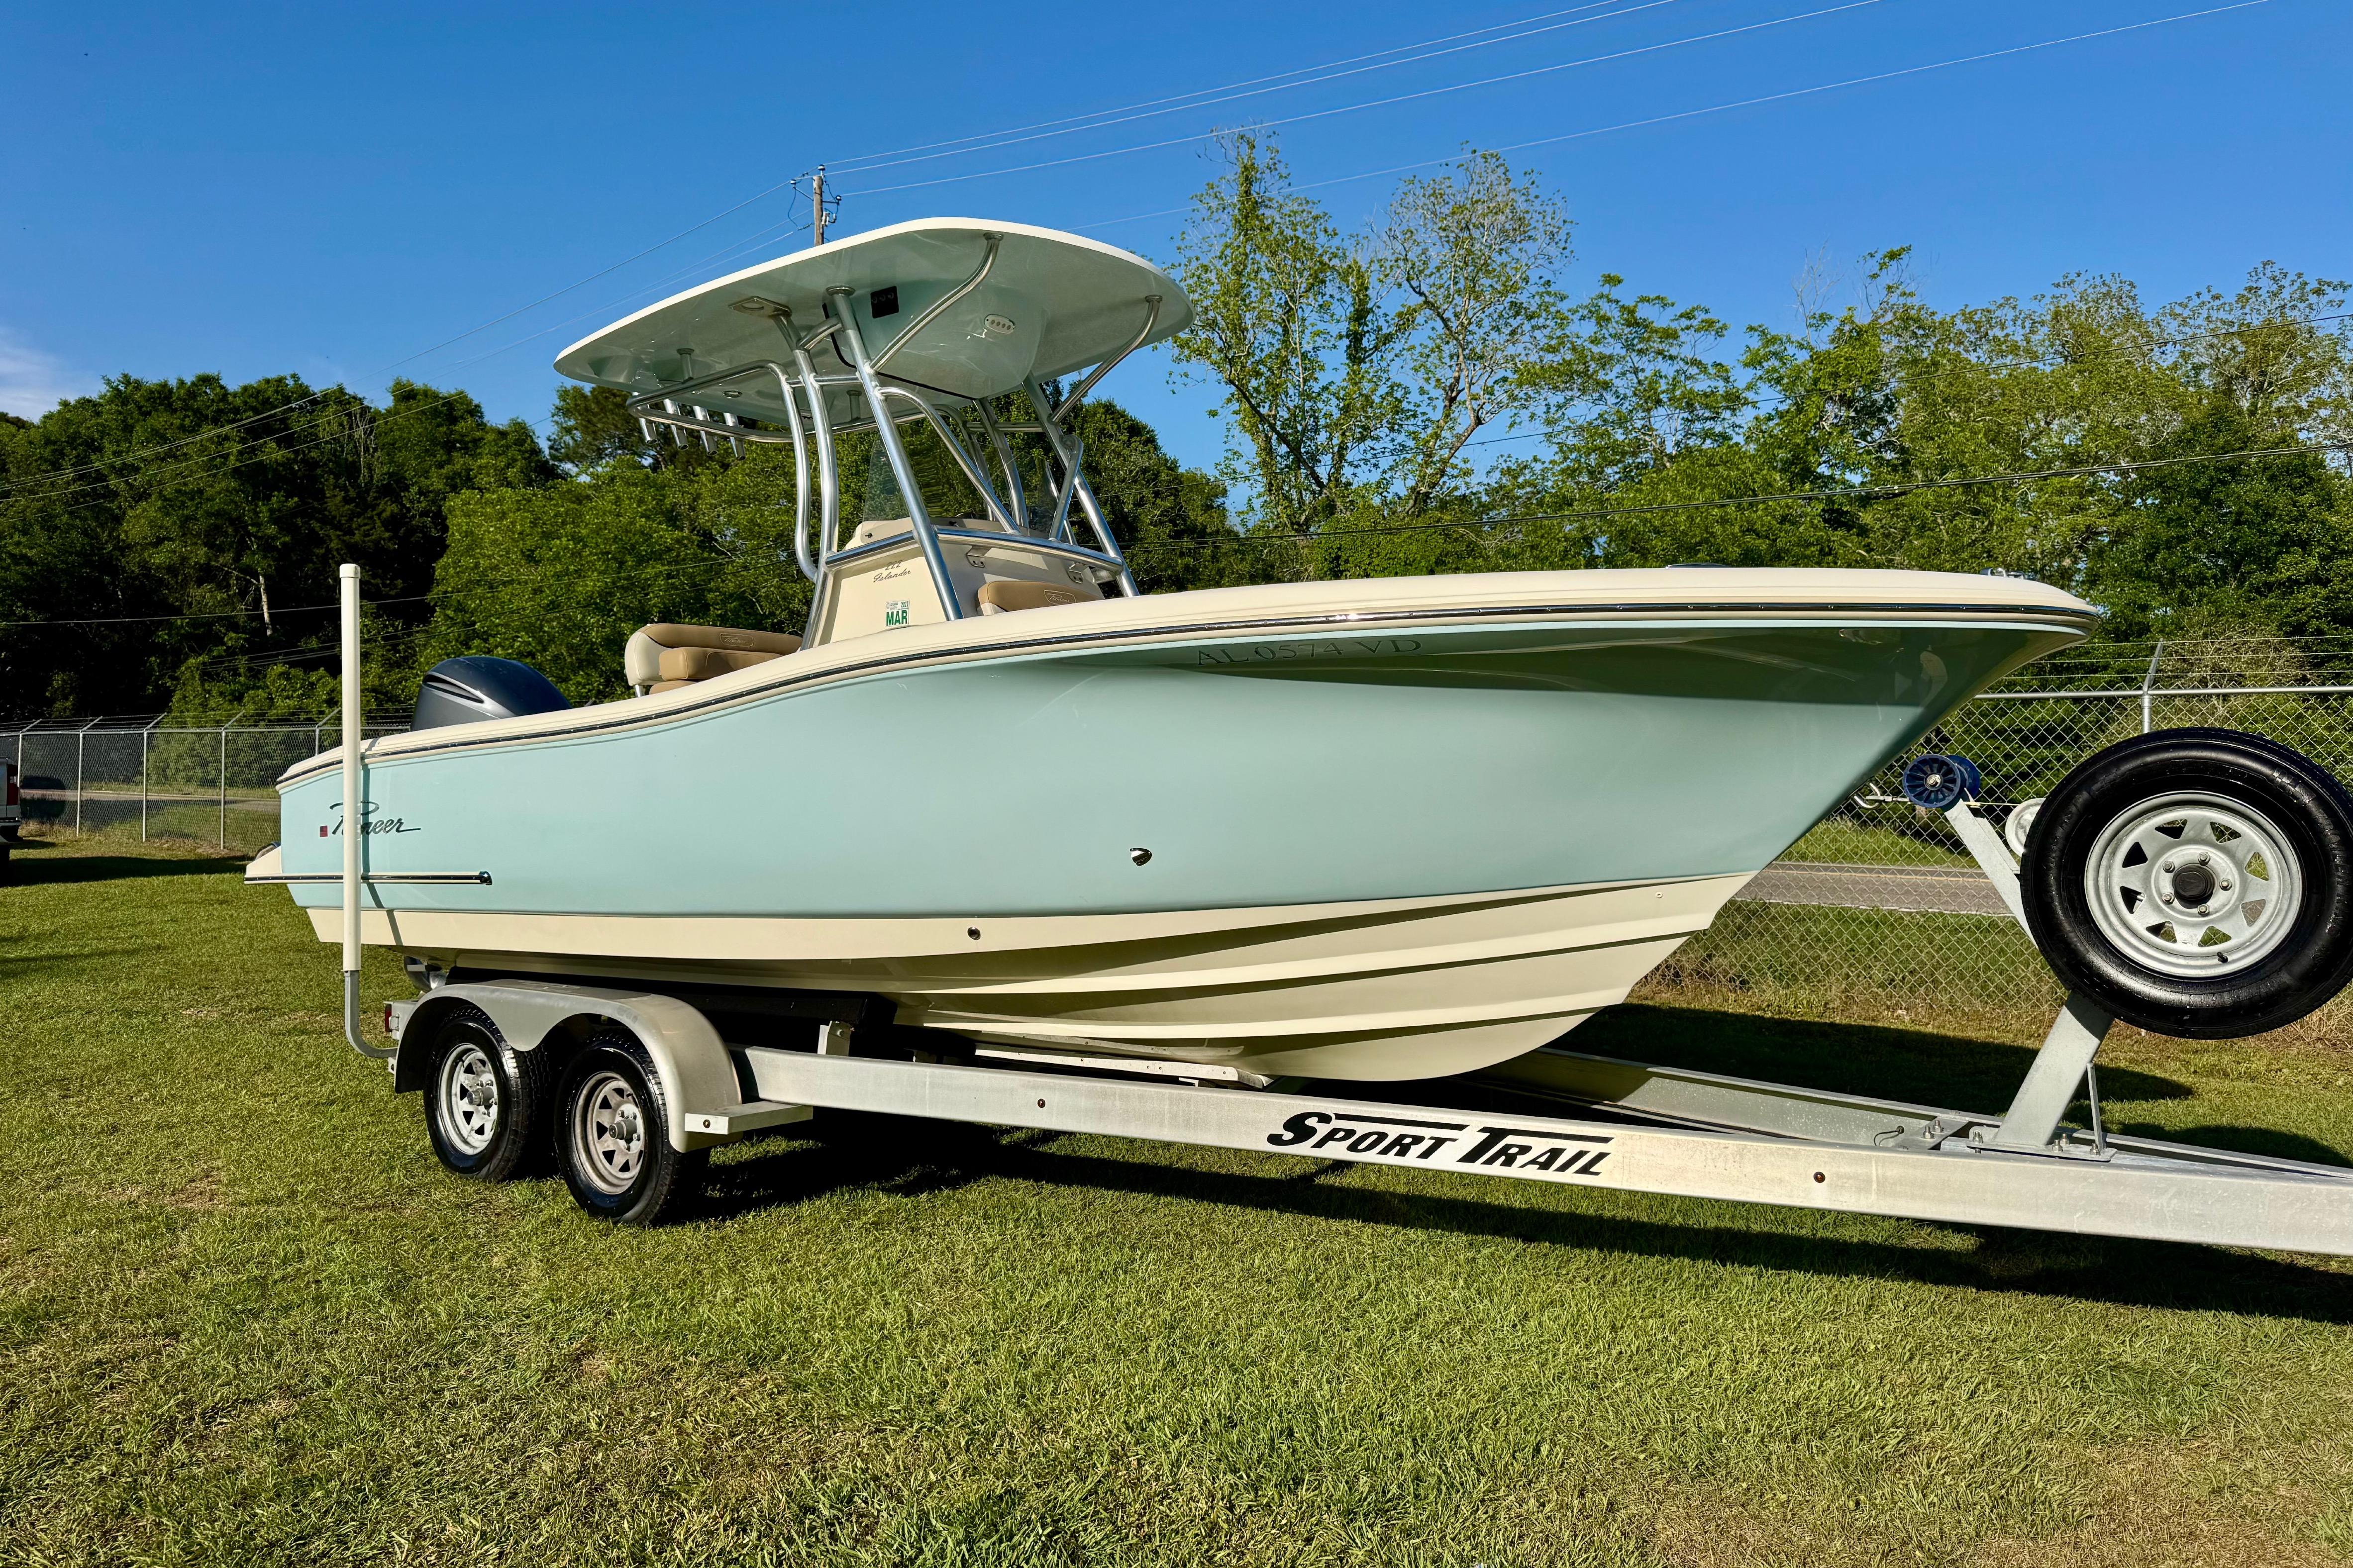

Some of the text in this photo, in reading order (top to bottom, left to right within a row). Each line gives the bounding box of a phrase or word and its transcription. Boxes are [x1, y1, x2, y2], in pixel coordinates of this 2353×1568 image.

[885, 559, 903, 571] 222
[873, 568, 912, 583] Islander
[886, 609, 908, 626] MAR
[1198, 639, 1422, 666] AL 0574 VD
[1266, 1111, 1615, 1176] SPORT TRAIL
